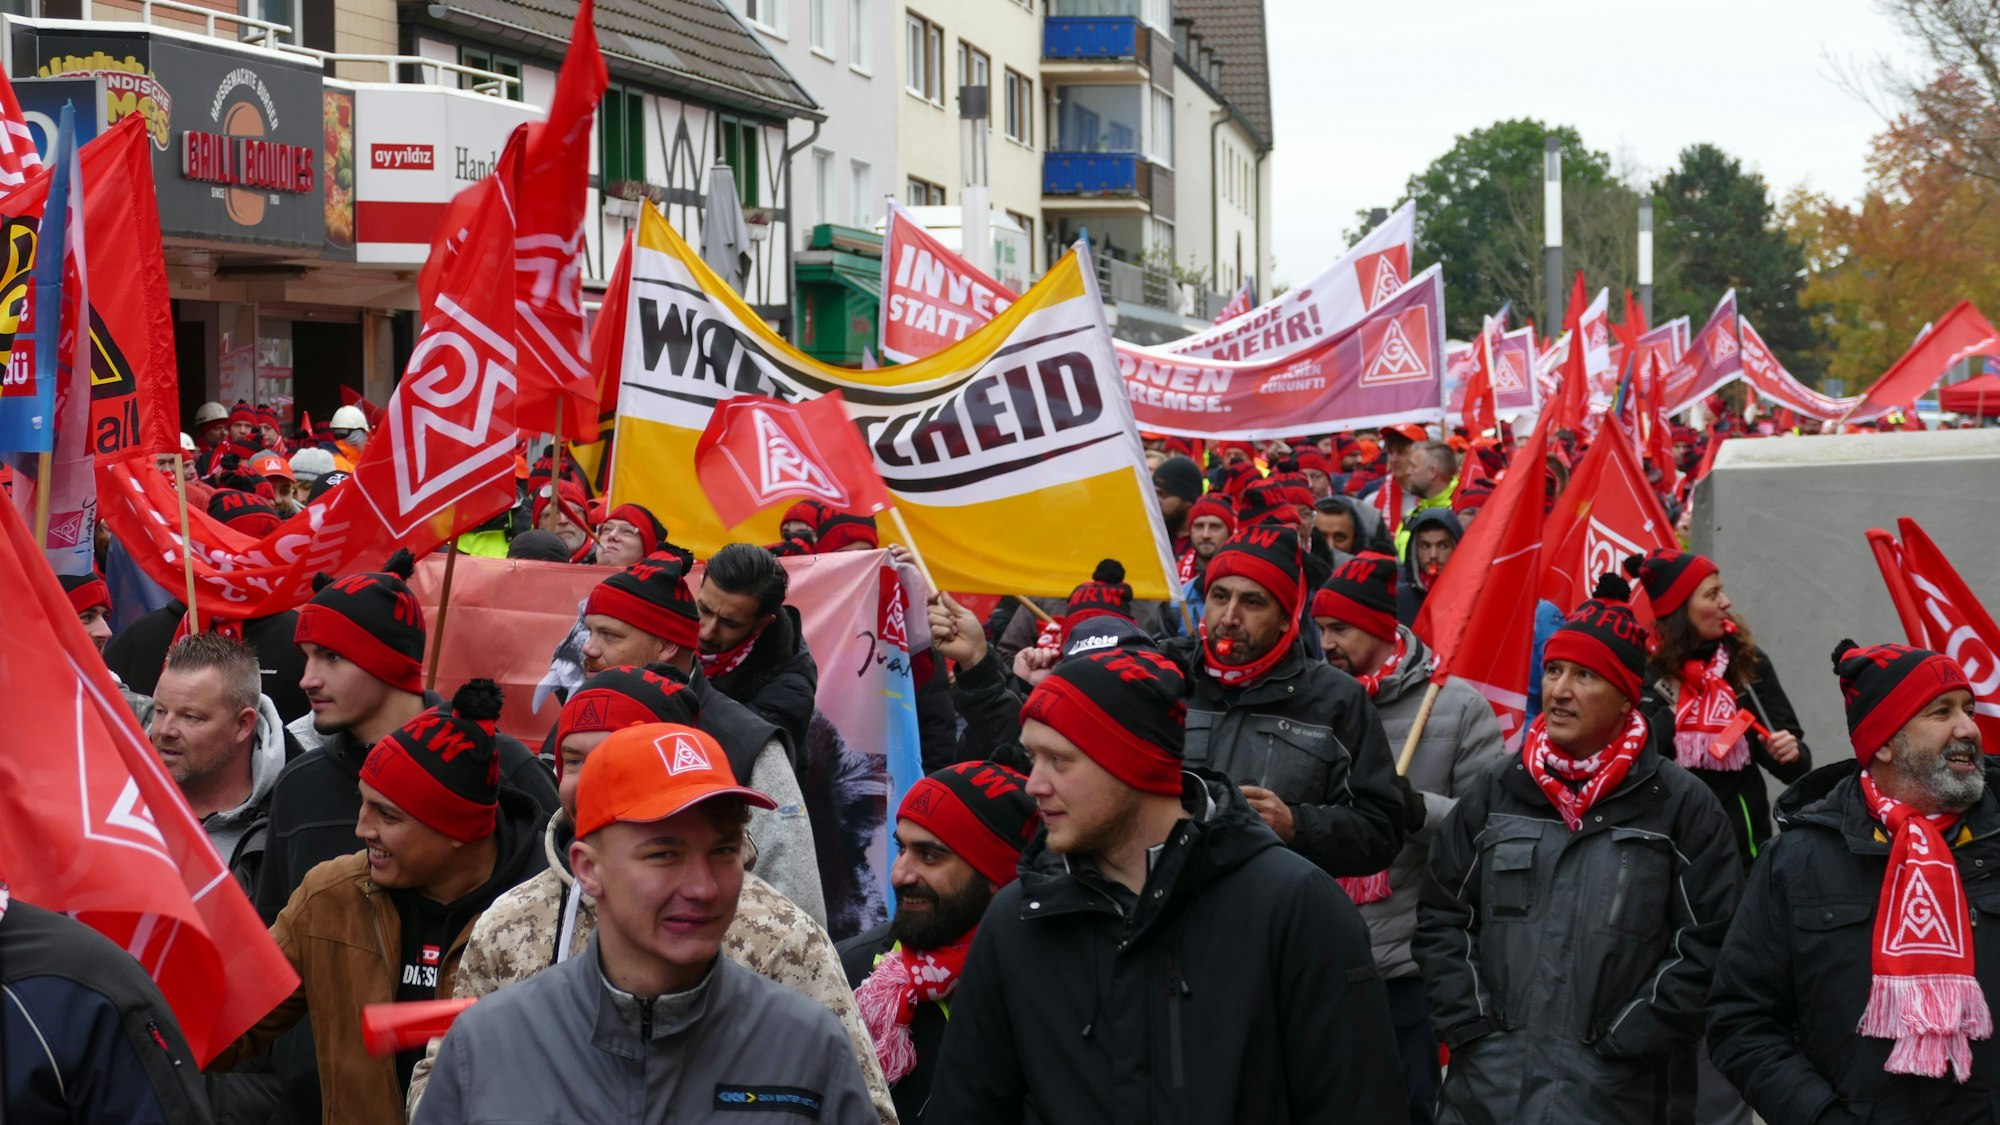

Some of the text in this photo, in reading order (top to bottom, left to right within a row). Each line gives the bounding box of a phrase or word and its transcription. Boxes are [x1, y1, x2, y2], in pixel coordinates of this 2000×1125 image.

[210, 68, 279, 132] HAUSGEMACHTE BURGER
[183, 131, 239, 186] GRILL
[888, 293, 973, 342] STATT
